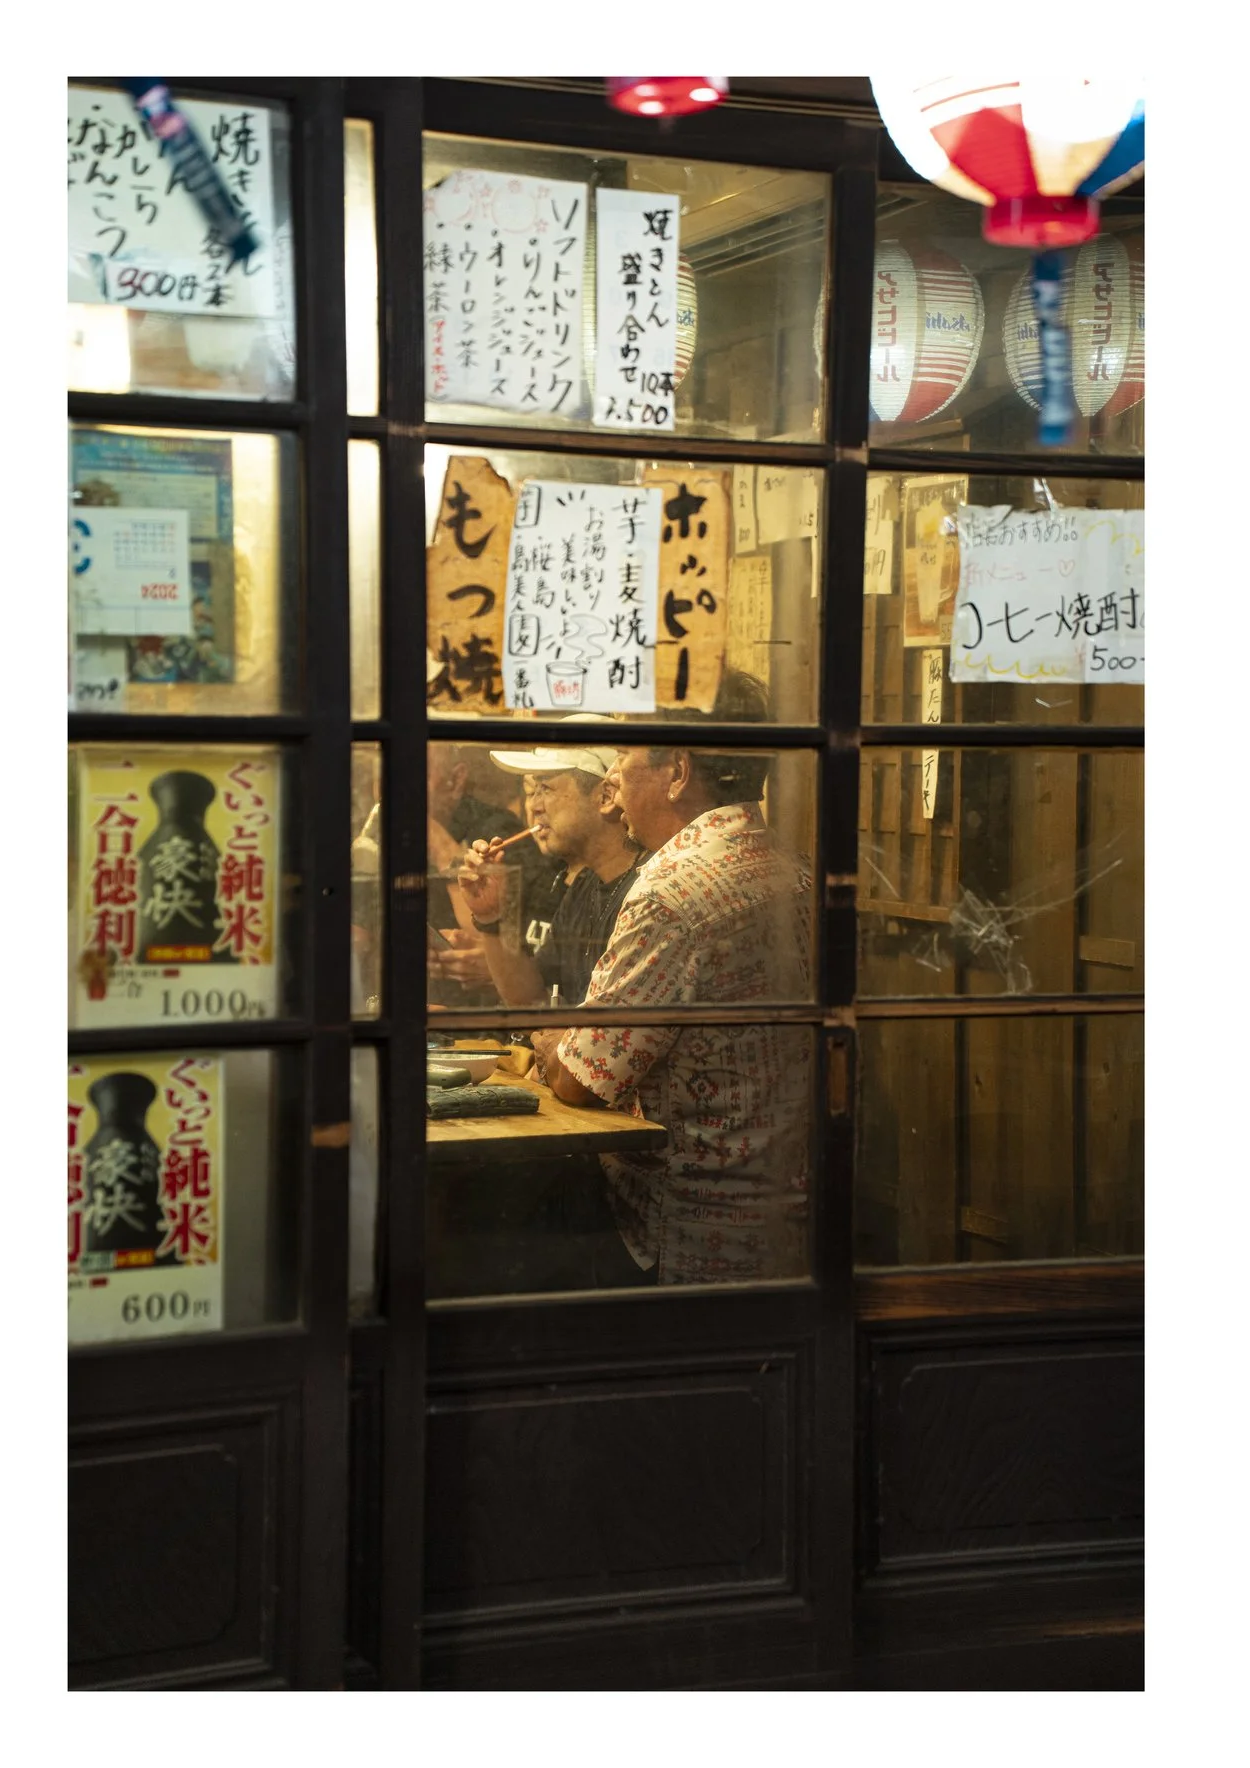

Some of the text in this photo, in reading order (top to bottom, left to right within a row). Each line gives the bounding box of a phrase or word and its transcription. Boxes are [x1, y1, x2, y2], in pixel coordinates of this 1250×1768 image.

[550, 198, 580, 413] ソフトドリンク
[617, 252, 646, 384] 盛り合わせ
[643, 208, 674, 328] 焼きとん
[662, 483, 718, 701] ホッピー
